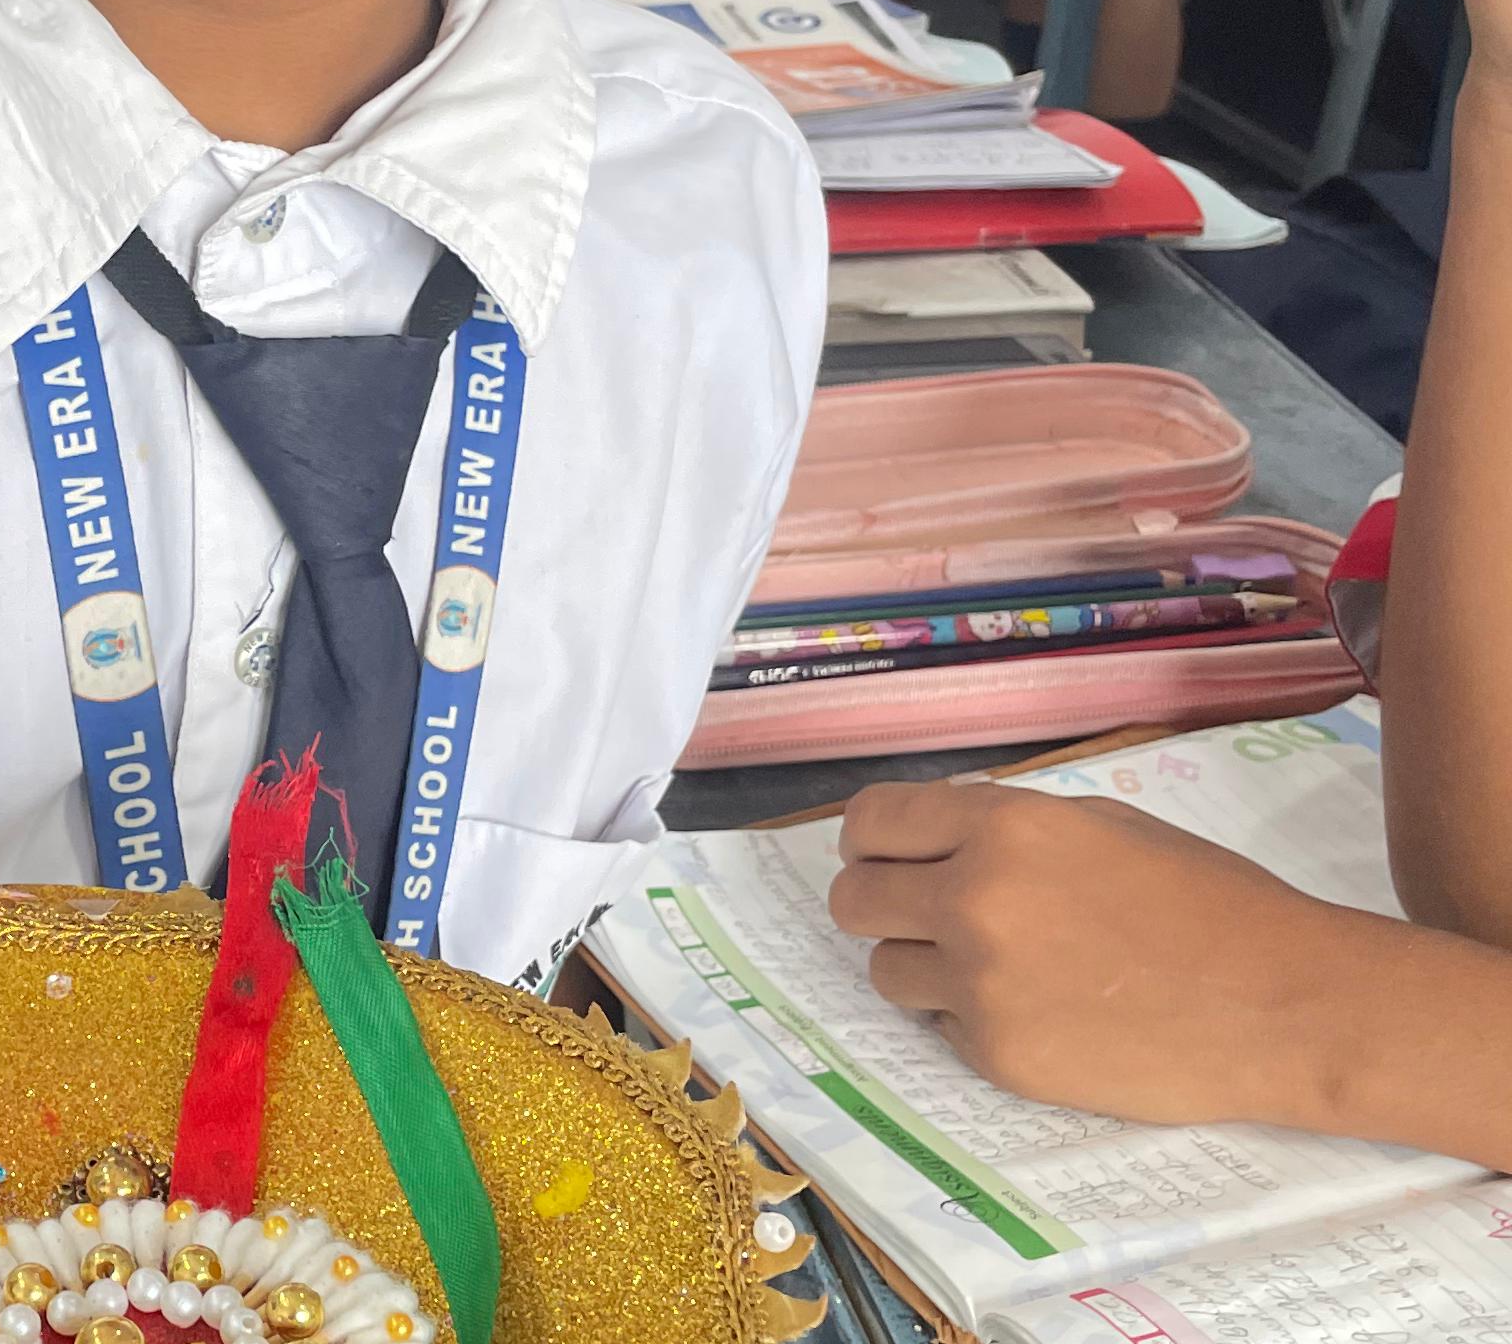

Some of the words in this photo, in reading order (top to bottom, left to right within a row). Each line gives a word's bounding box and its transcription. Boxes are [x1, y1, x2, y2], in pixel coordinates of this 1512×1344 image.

[42, 356, 98, 459] ERA
[464, 342, 507, 434] ERA
[61, 475, 119, 585] NEW
[450, 447, 496, 557] NEW
[403, 704, 459, 901] SCHOOL
[849, 1103, 1001, 1225] Assignments
[998, 1189, 1041, 1220] Subject
